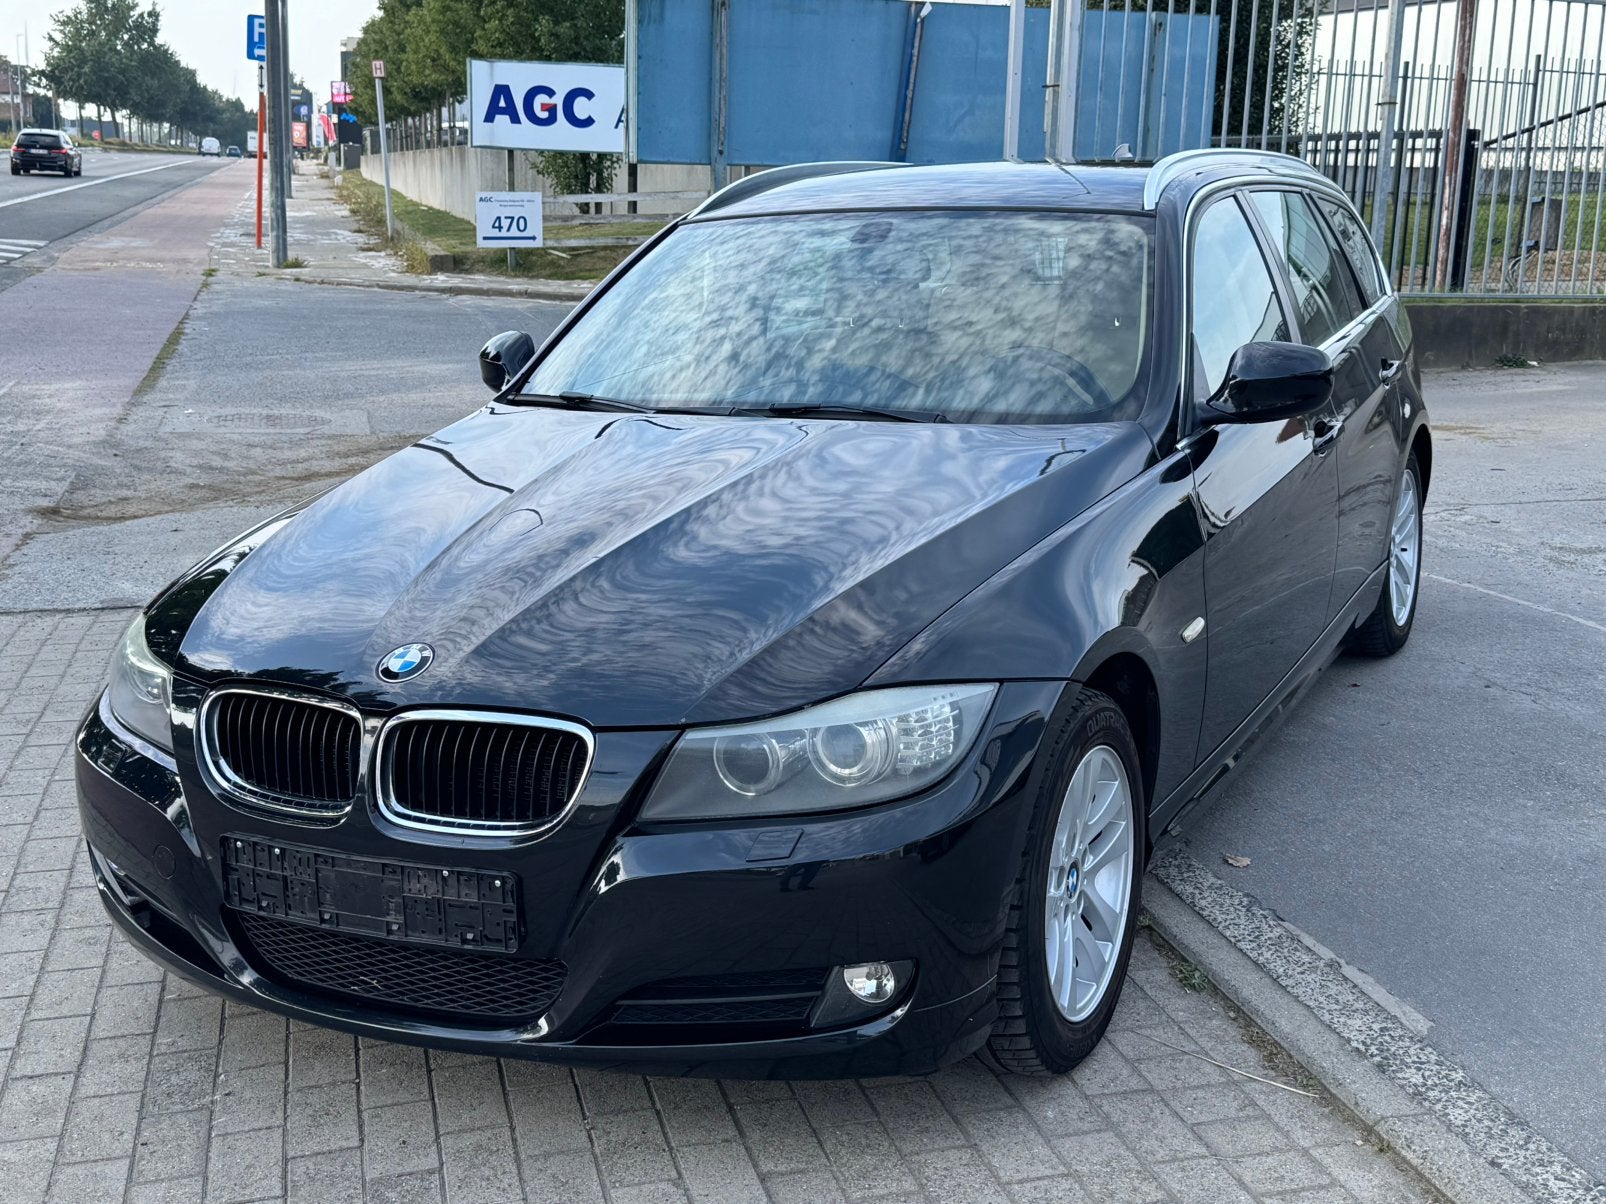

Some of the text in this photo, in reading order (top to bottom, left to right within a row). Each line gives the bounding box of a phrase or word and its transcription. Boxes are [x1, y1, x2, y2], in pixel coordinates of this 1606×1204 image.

[374, 62, 383, 75] H
[483, 84, 596, 129] AGC
[491, 215, 528, 233] 470
